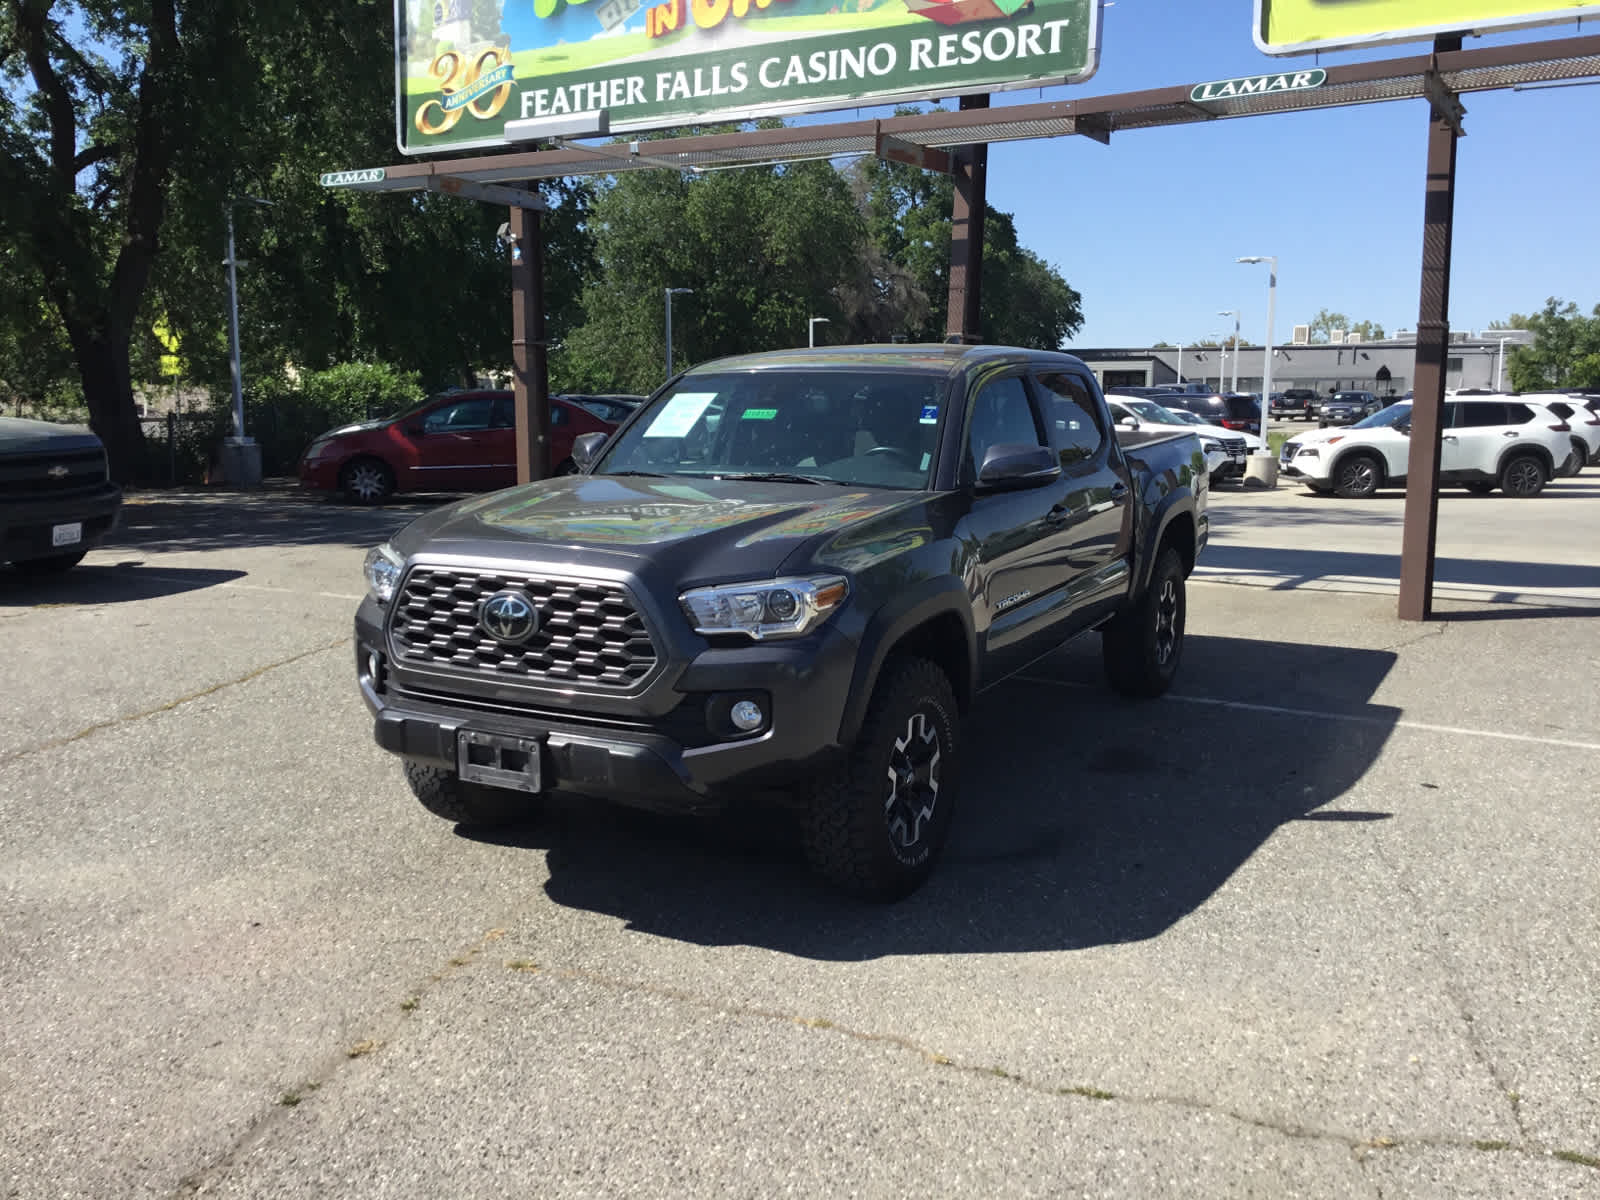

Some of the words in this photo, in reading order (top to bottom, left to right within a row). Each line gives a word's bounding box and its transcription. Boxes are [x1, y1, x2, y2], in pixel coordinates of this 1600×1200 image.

[645, 0, 683, 38] IN
[444, 67, 508, 109] ANNIVERSARY
[519, 75, 648, 119] FEATHER
[655, 63, 748, 103] FALLS
[758, 42, 897, 88] CASINO
[908, 19, 1070, 71] RESORT
[1201, 71, 1313, 99] LAMAR
[414, 46, 513, 135] 30
[325, 170, 378, 185] LAMAR
